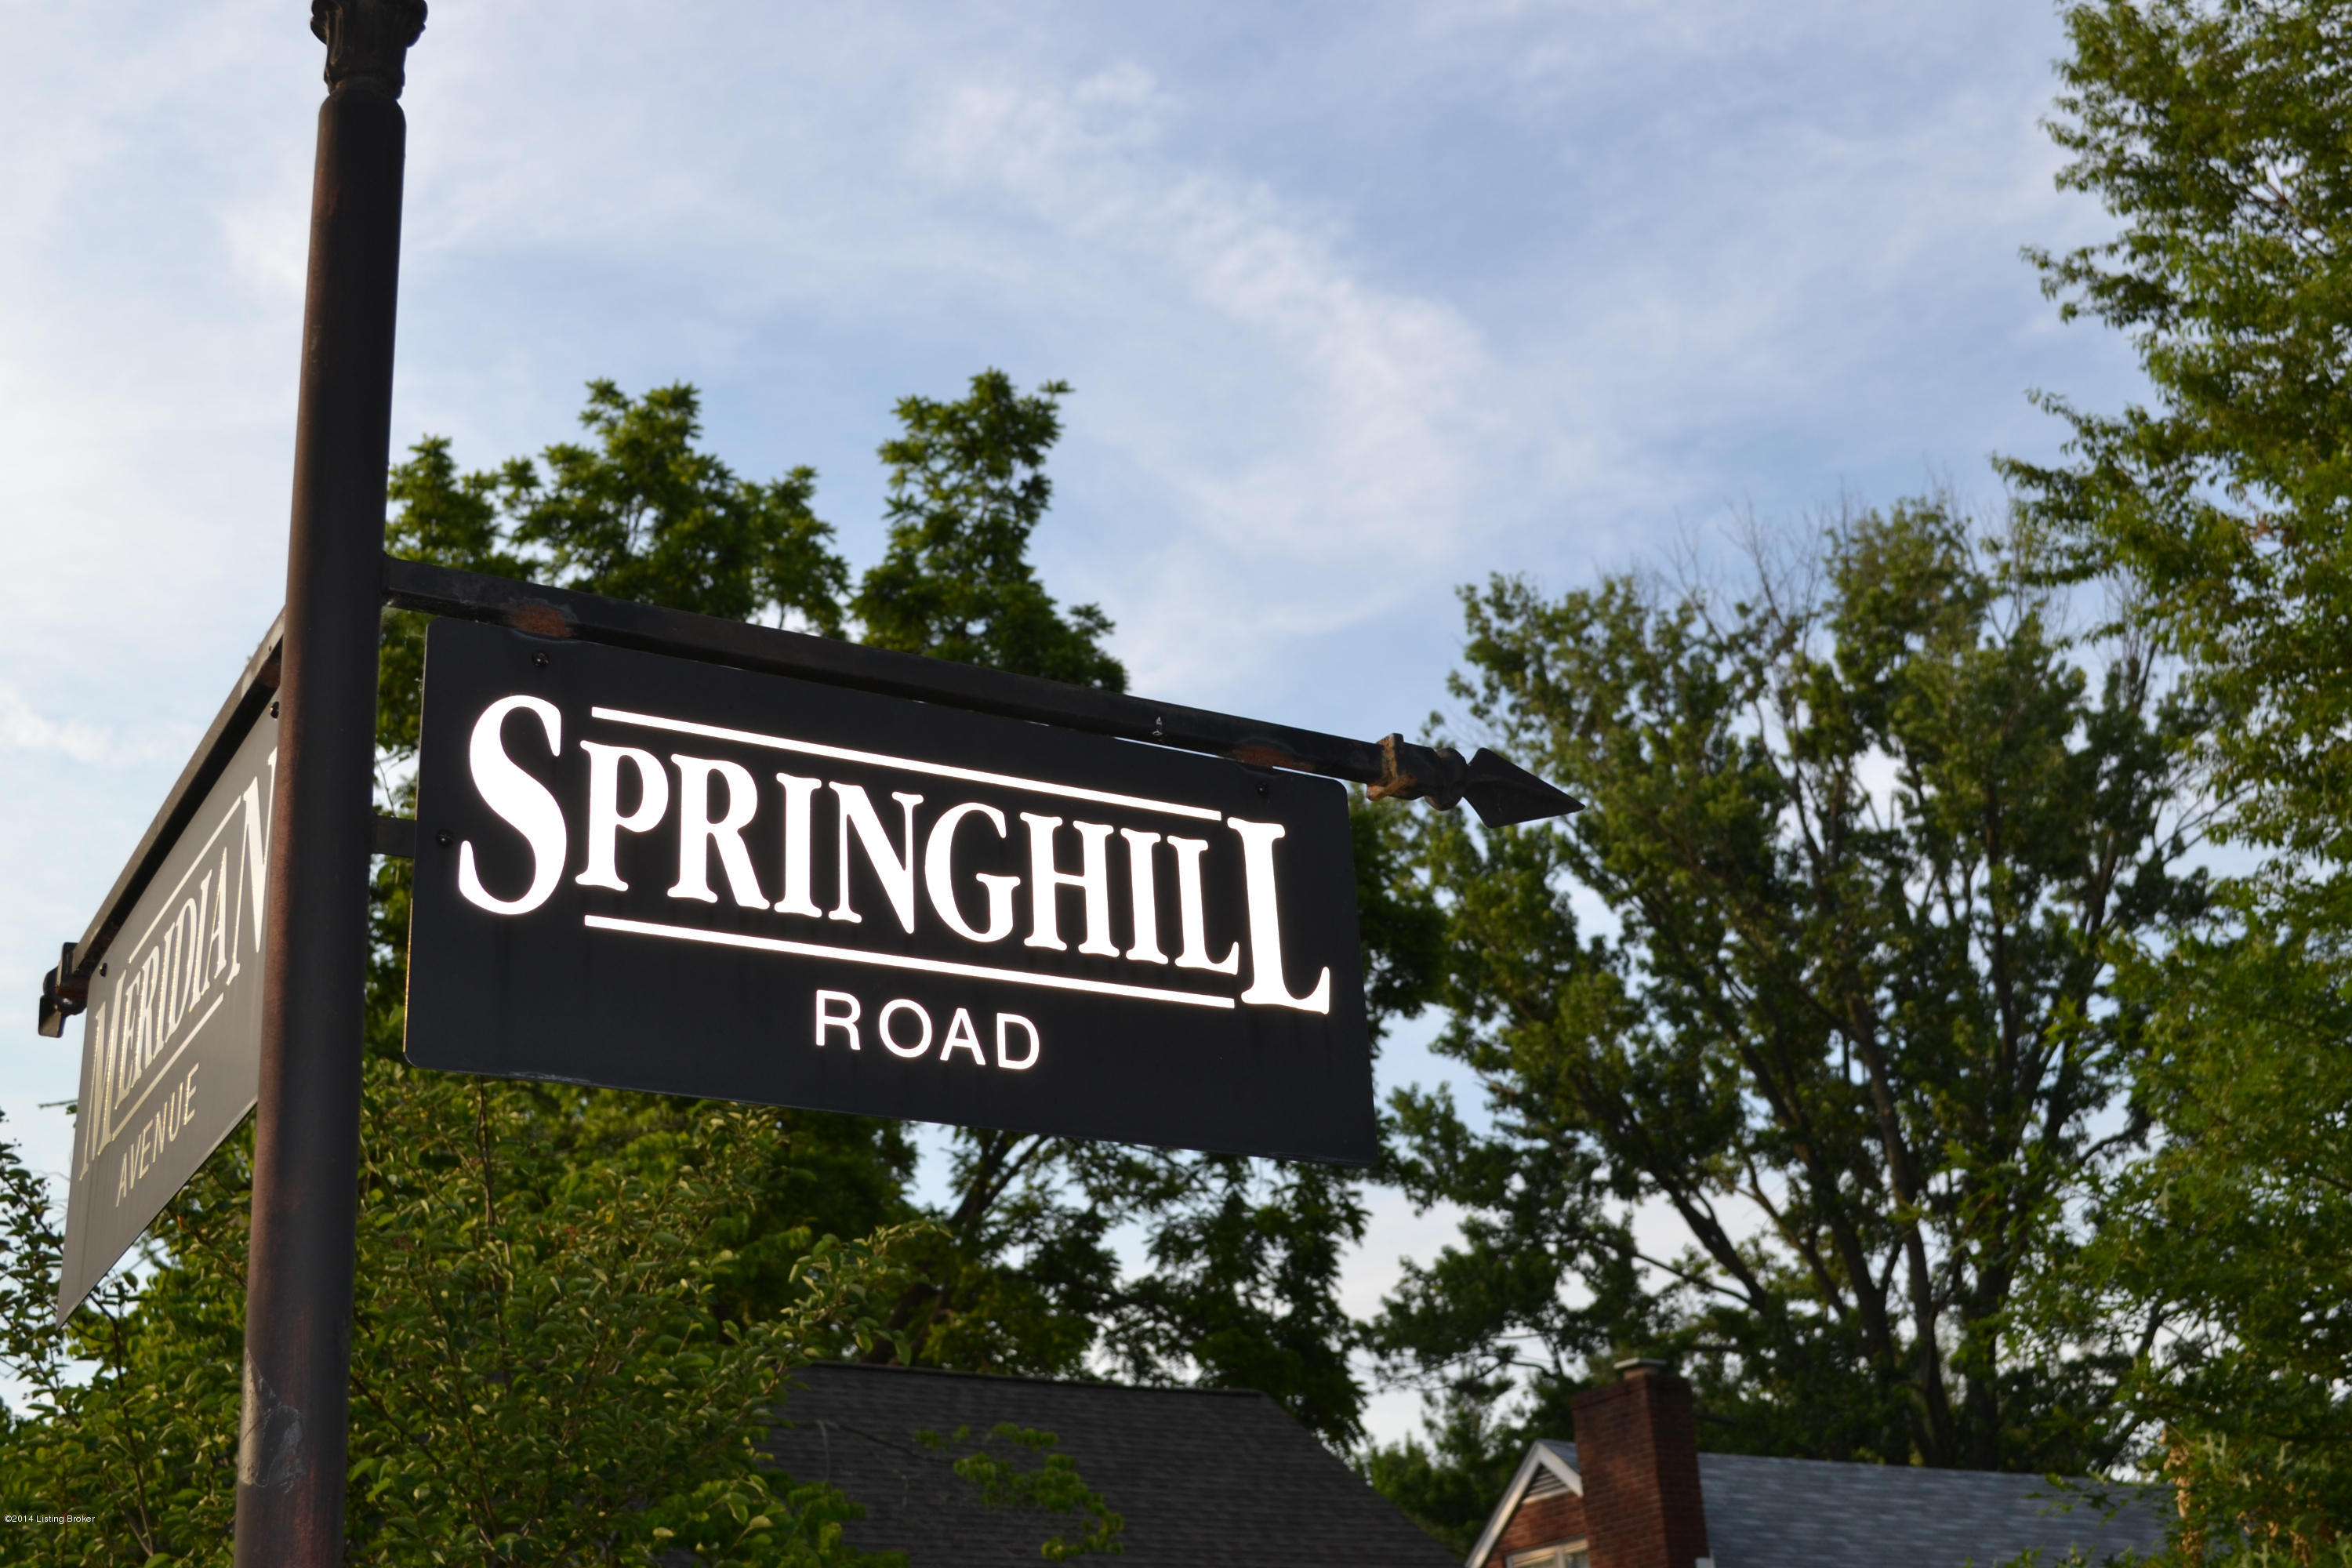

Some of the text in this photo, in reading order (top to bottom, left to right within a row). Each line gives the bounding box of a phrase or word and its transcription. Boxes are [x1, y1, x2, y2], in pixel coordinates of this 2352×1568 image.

[79, 746, 278, 1181] MERIDIAN
[458, 695, 1330, 1015] SPRINGHILL
[116, 1062, 199, 1208] AVENUE
[815, 989, 1040, 1070] ROAD
